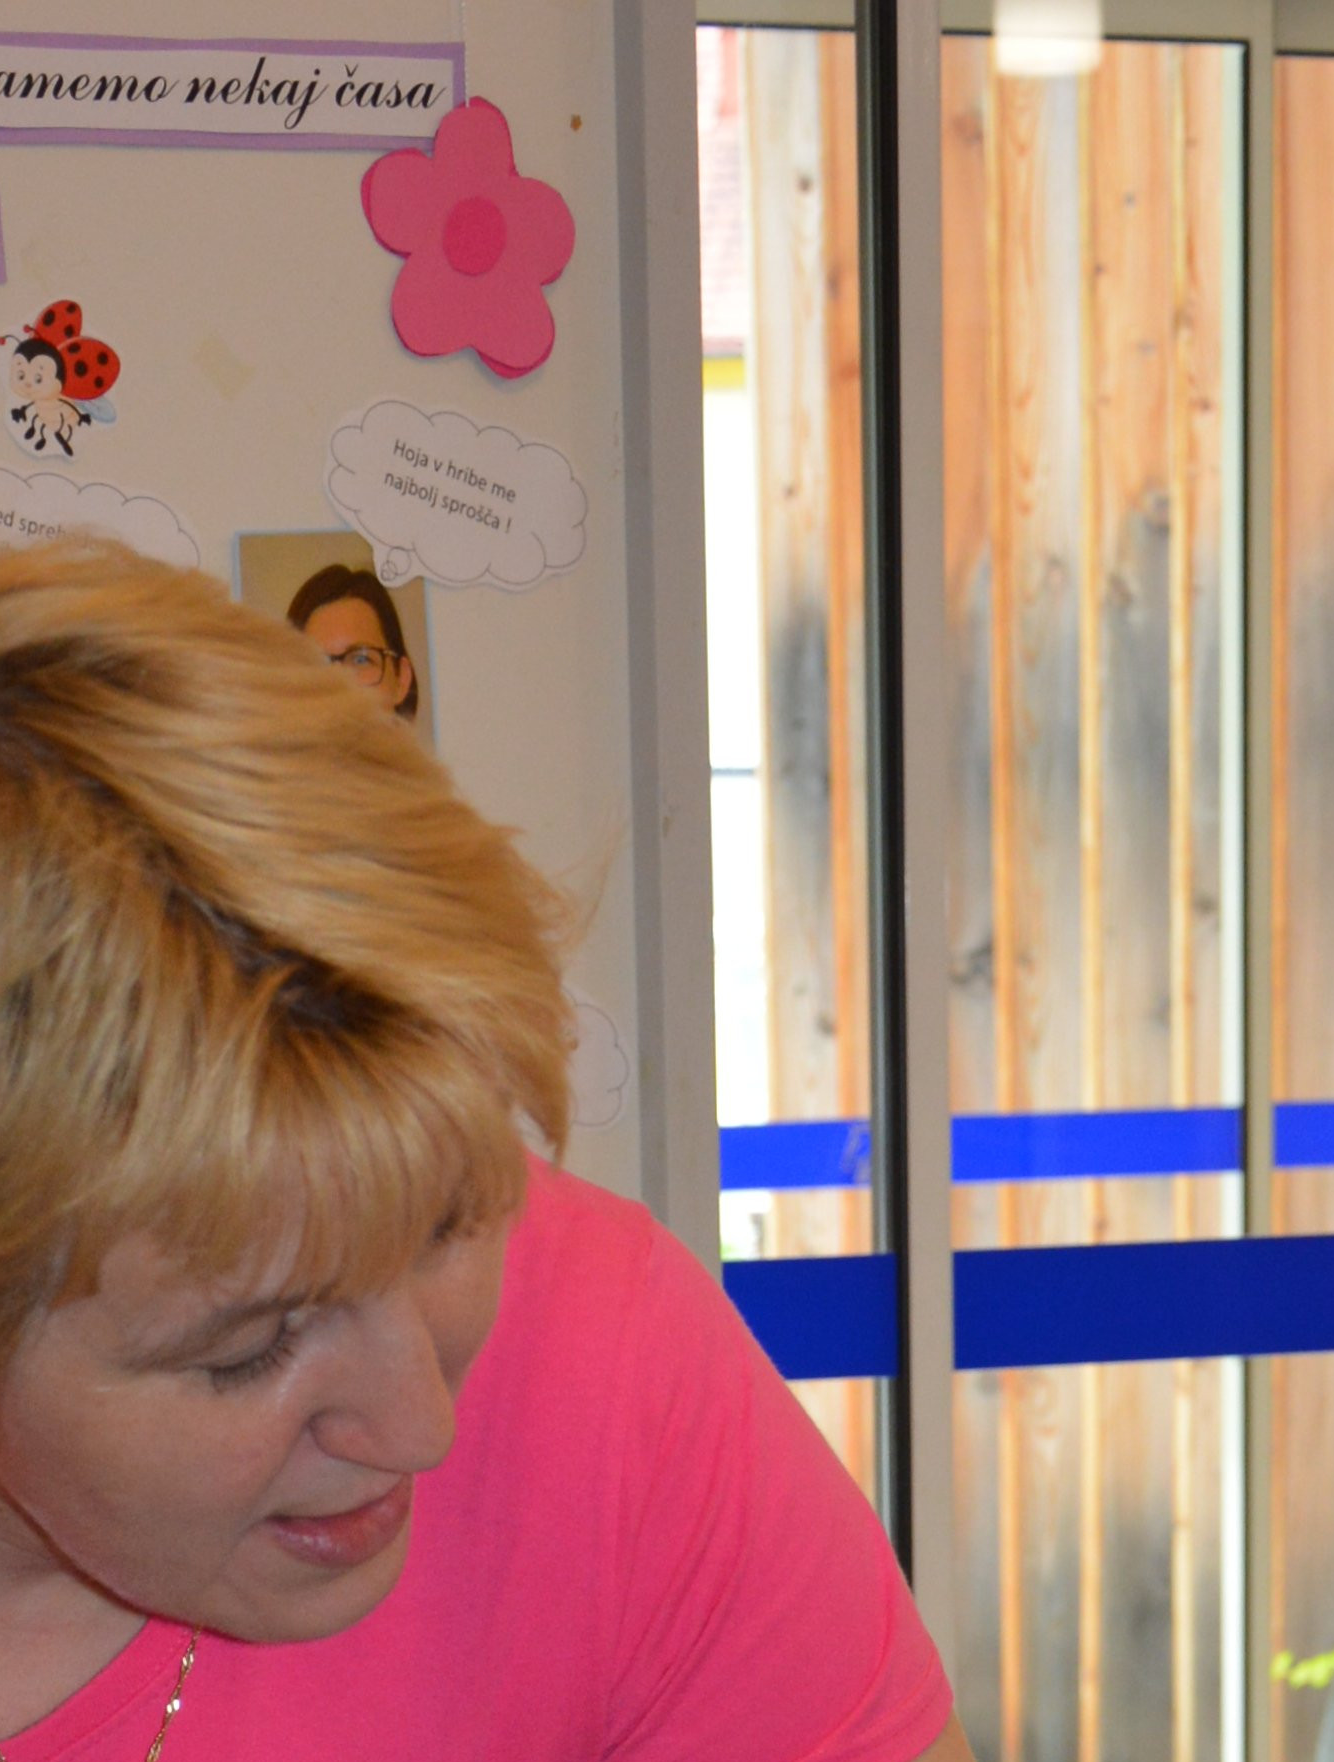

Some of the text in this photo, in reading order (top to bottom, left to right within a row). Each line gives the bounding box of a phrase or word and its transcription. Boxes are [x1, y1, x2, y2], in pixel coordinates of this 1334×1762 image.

[185, 56, 329, 129] nekaj
[335, 63, 445, 110] časa
[384, 471, 512, 533] najbolj sprošča !
[393, 438, 516, 503] Hoja v hribe me
